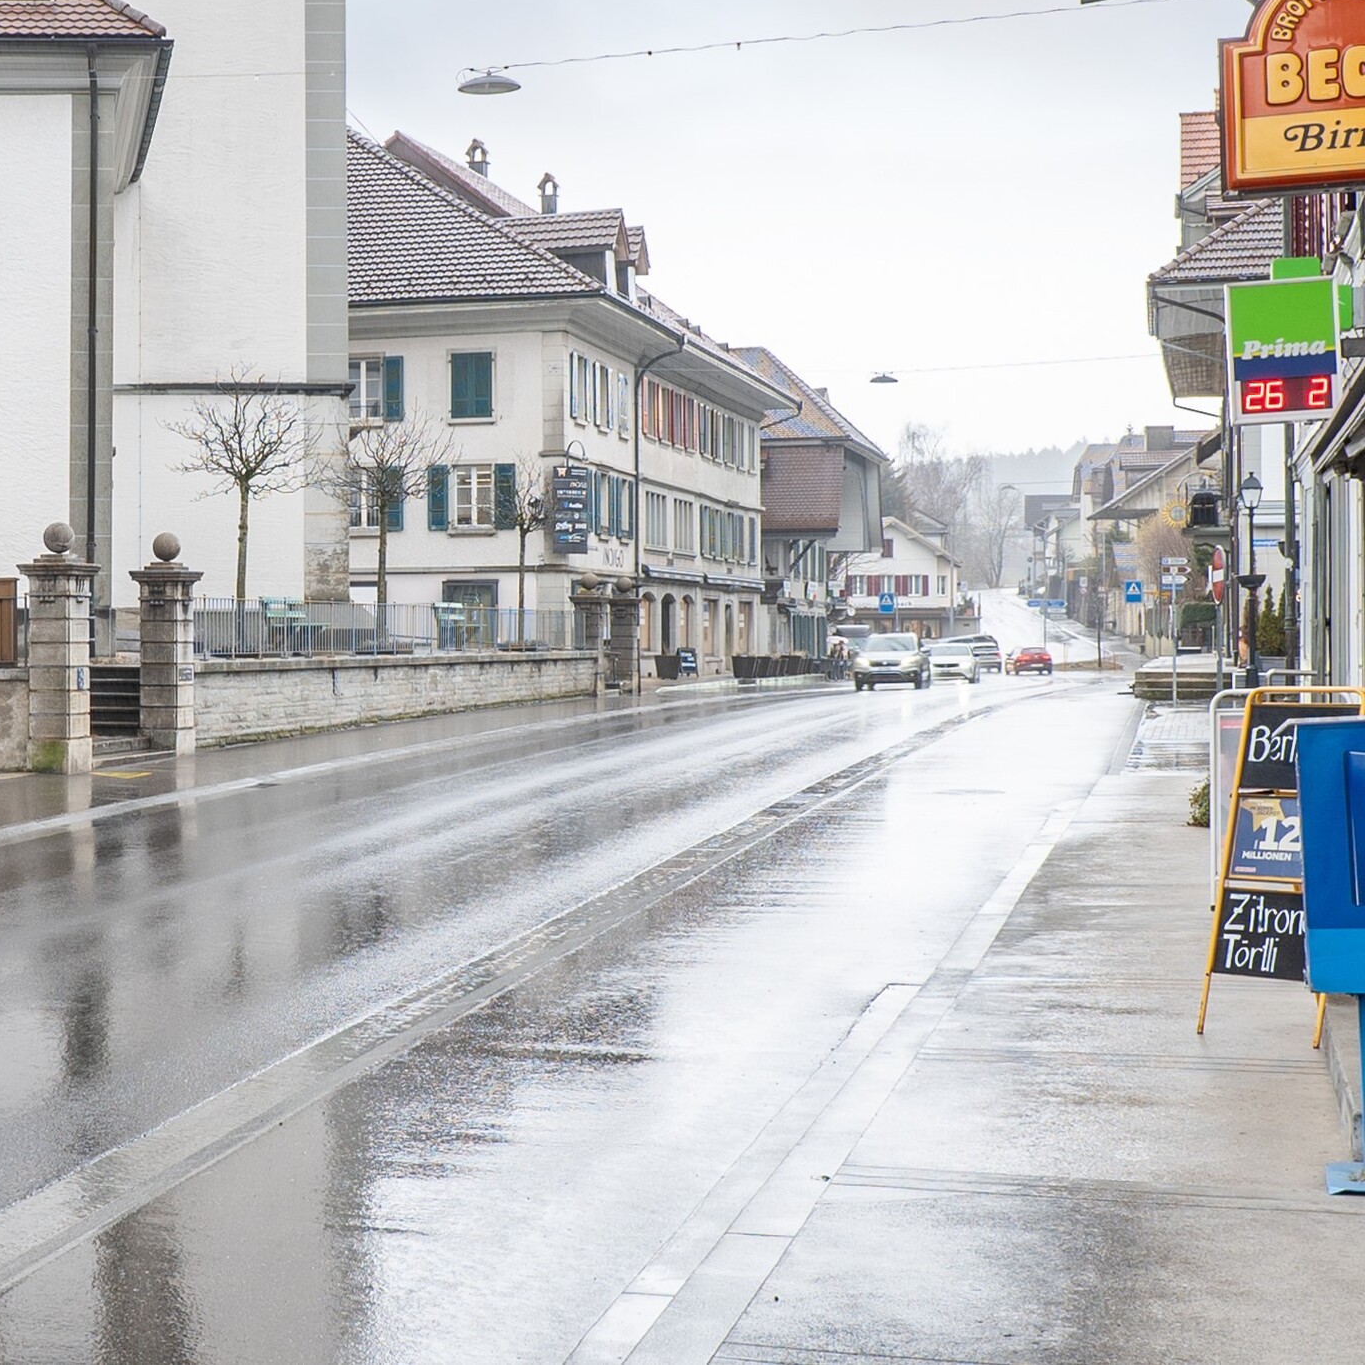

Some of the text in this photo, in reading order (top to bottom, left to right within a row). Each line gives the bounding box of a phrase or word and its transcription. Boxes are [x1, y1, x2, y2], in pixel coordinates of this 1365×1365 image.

[1241, 338, 1326, 360] Prima
[1245, 378, 1328, 410] 26 2
[1241, 850, 1292, 862] MILLIONEN
[1224, 893, 1305, 935] Zitron
